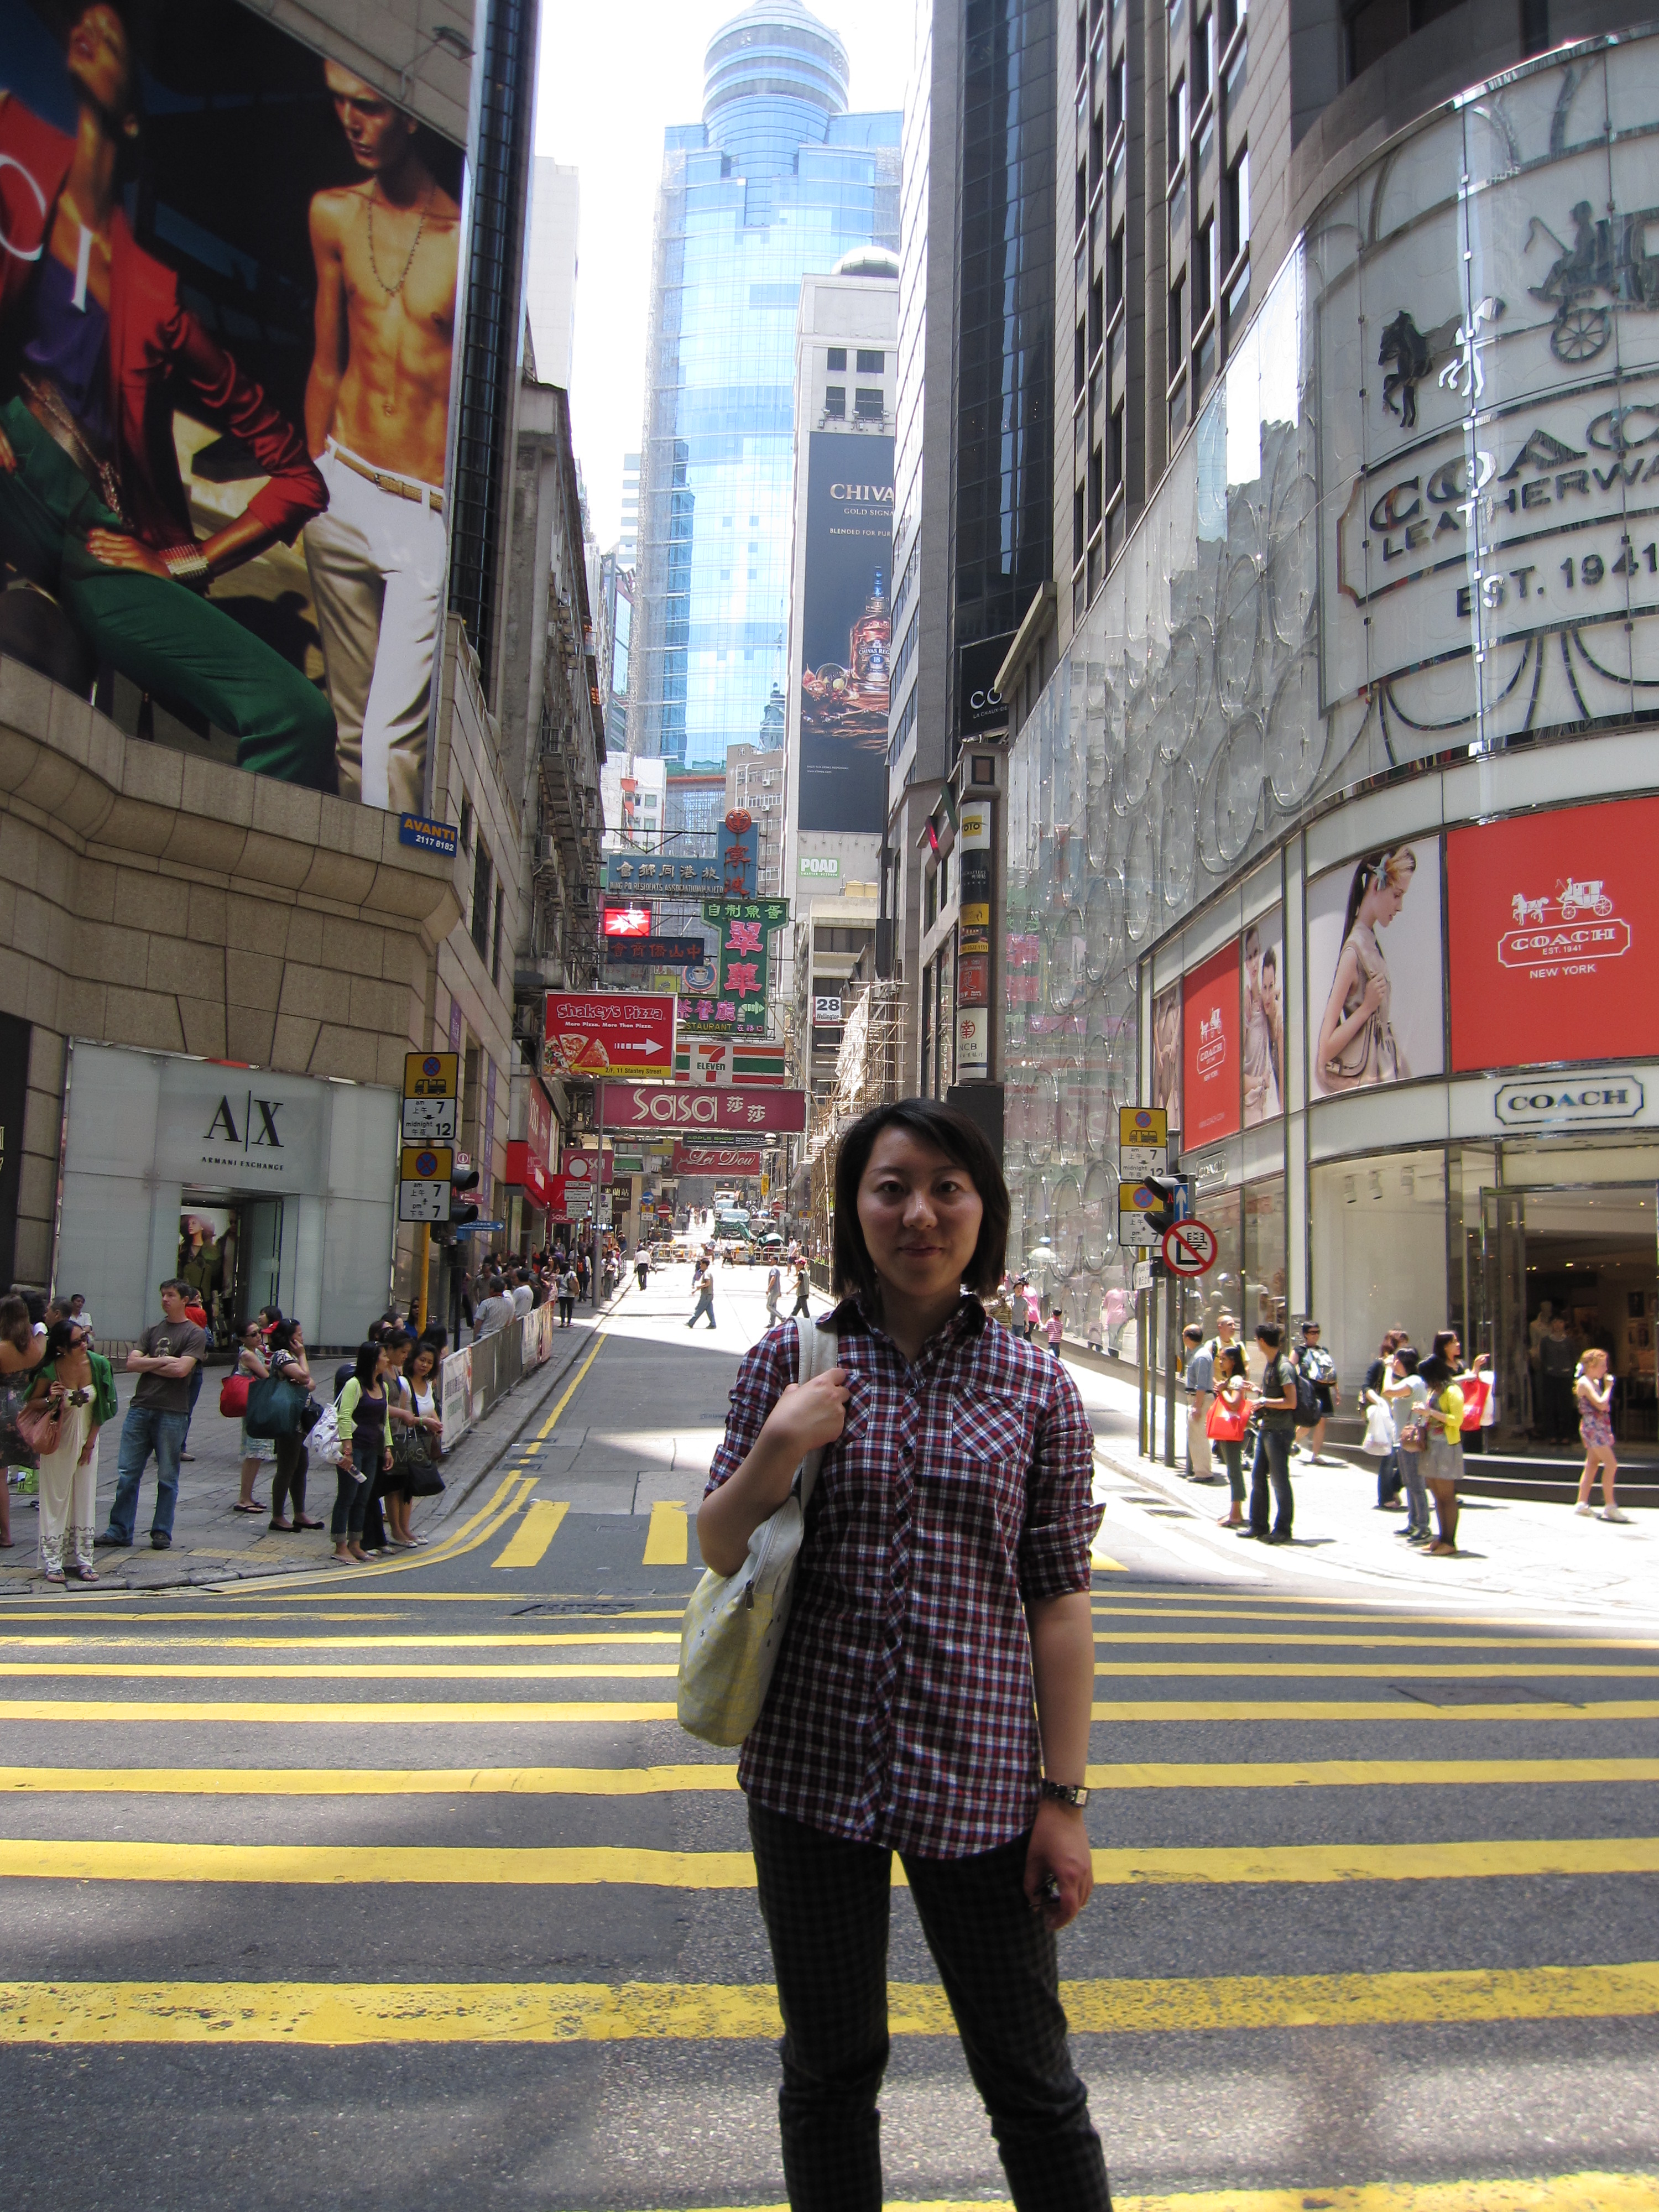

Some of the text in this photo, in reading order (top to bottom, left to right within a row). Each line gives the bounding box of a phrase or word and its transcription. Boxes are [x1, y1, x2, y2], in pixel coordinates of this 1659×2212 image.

[1369, 404, 1659, 532] COAC
[830, 483, 894, 502] CHIVA
[1383, 455, 1659, 561] LEATHERWA
[1457, 542, 1658, 618] EST. 1941
[971, 686, 1002, 709] CO
[980, 706, 1009, 717] CHAUX-DE-
[404, 818, 455, 841] AVANTI
[416, 834, 455, 852] 2117 8182
[801, 858, 838, 873] POAD
[610, 881, 622, 890] NING
[624, 882, 632, 890] PO
[634, 883, 663, 891] RESIDENTS
[1511, 927, 1615, 951] COACH
[1542, 945, 1582, 956] EST. 1941
[724, 920, 764, 998] 翠華
[1530, 964, 1596, 979] NEW YORK
[557, 1003, 663, 1020] Shakey's Pizza
[817, 999, 839, 1011] 28
[686, 1022, 732, 1031] STAURANT
[959, 1042, 977, 1051] NCB
[1200, 1042, 1223, 1062] COACH
[698, 1045, 726, 1082] 7
[1507, 1089, 1627, 1110] COACH
[436, 1101, 445, 1114] 7
[727, 1096, 766, 1123] 莎莎
[436, 1123, 451, 1136] 12
[1150, 1150, 1157, 1160] 7
[202, 1156, 284, 1171] ARMANI EXCHANGE
[1150, 1167, 1164, 1177] 12
[433, 1185, 441, 1197] 7
[432, 1206, 440, 1218] 7
[395, 1448, 424, 1463] M&S
